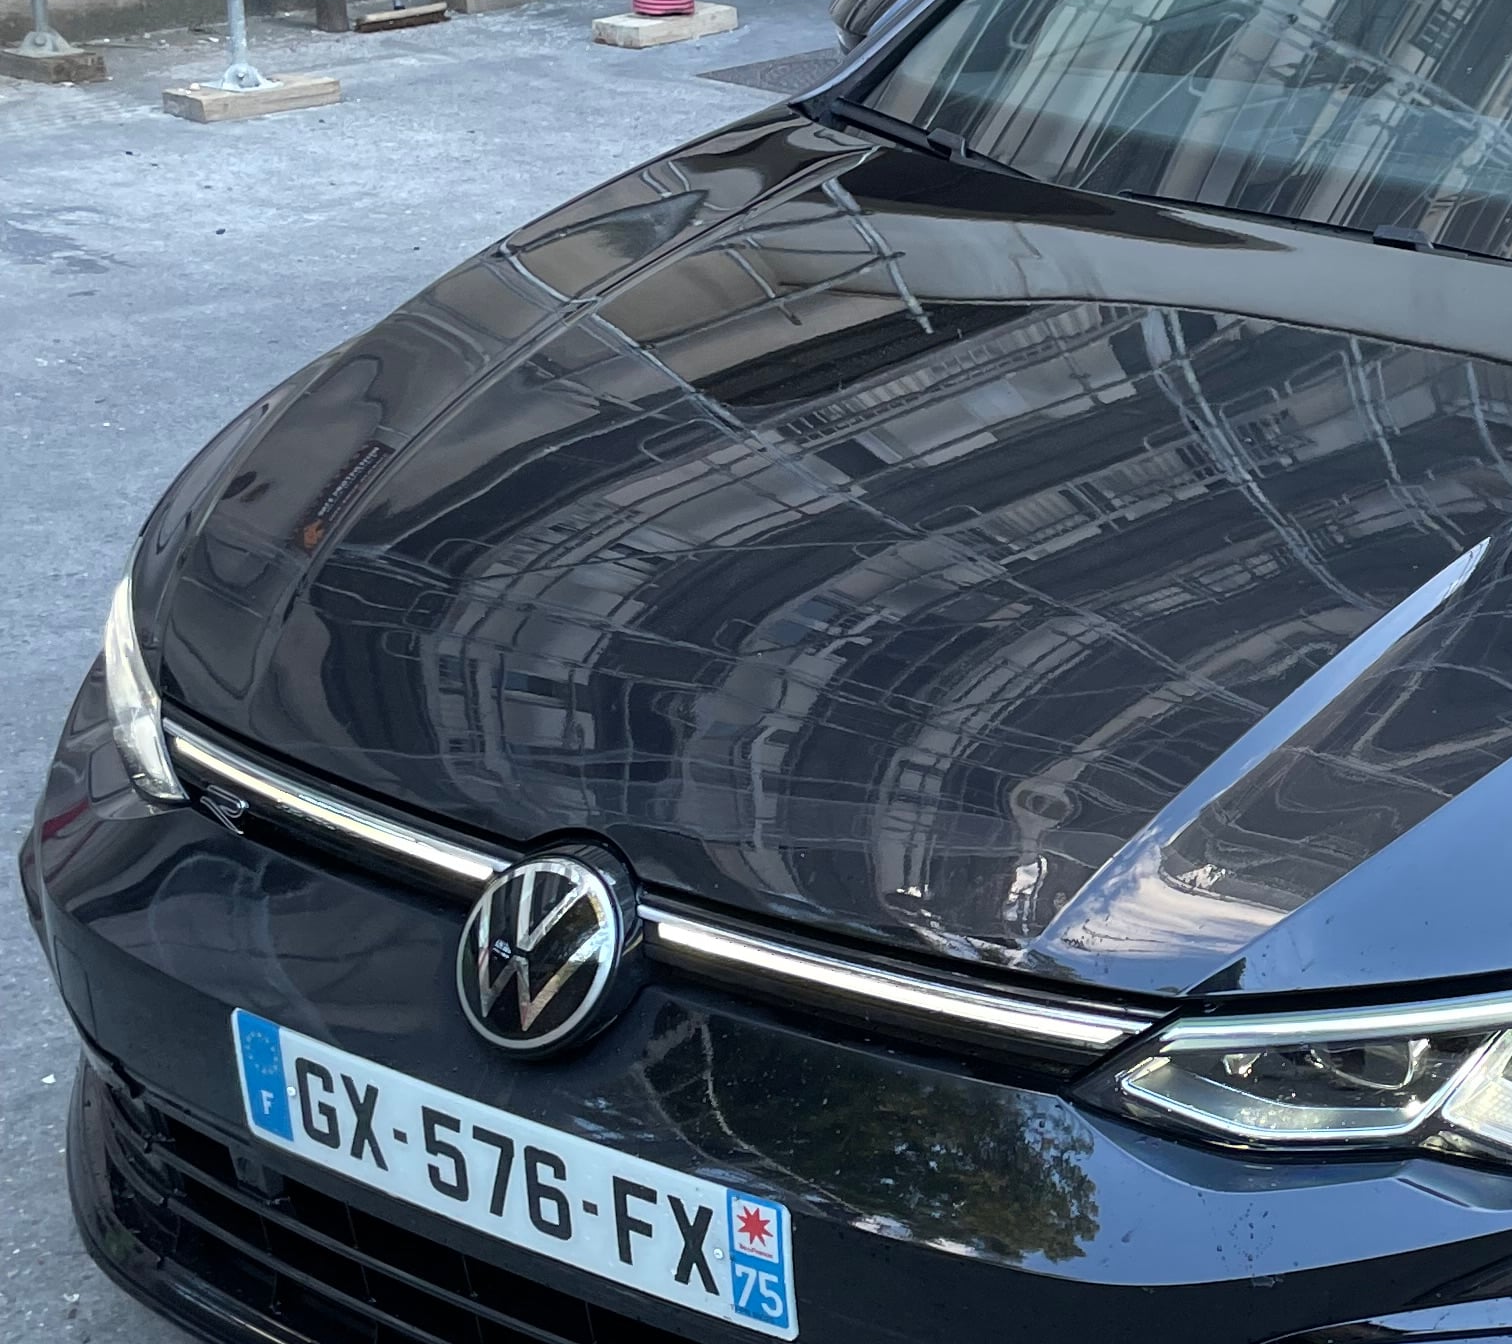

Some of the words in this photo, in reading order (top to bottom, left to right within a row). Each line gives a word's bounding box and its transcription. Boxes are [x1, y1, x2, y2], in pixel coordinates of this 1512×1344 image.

[261, 1089, 274, 1115] F
[295, 1056, 720, 1296] GX-576-FX
[735, 1263, 784, 1318] 75
